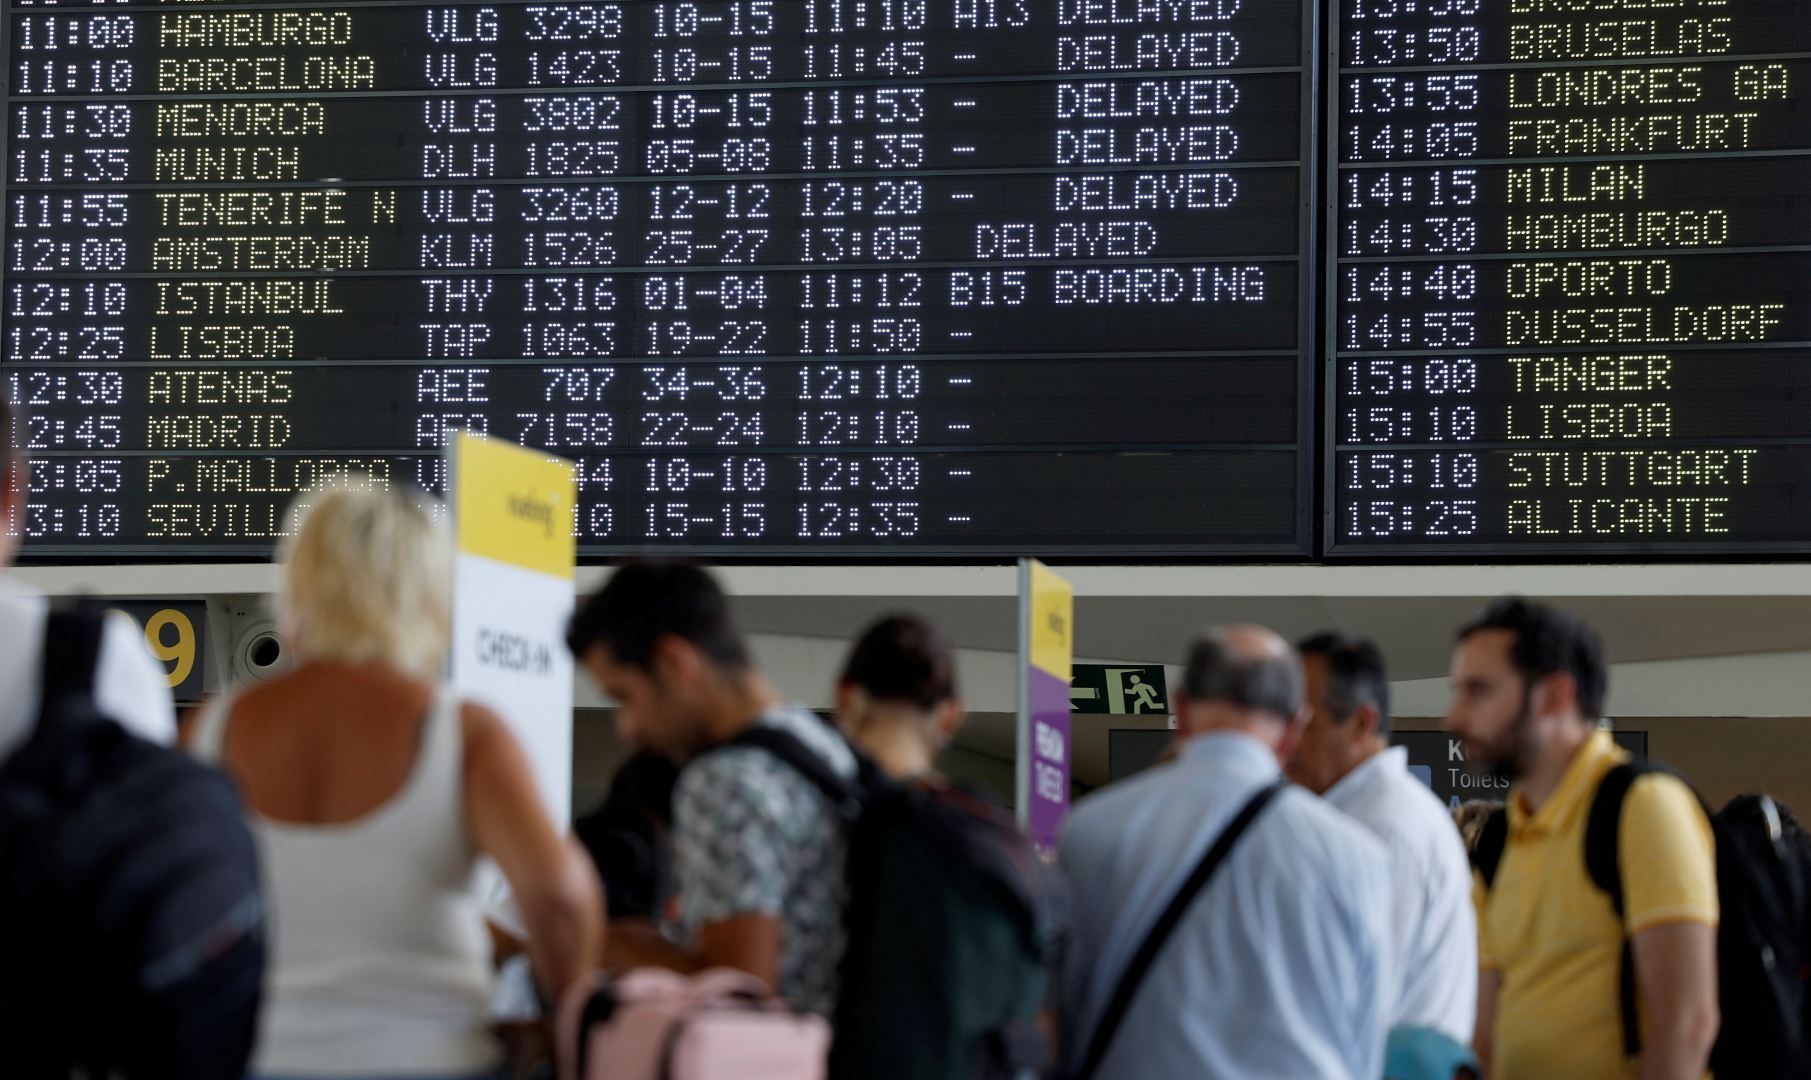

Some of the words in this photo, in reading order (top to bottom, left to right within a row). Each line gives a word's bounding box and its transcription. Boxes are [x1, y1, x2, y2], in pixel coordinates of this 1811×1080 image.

[21, 16, 133, 49] 11:00
[161, 12, 351, 47] HAMBURGO
[428, 9, 497, 42] VLG
[526, 6, 621, 40] 3298
[655, 2, 772, 37] 10-15
[806, 0, 925, 32] 11:10
[1351, 27, 1479, 65] 13:50
[1511, 18, 1731, 59] BRUSELAS
[20, 60, 132, 93] 11:10
[160, 56, 374, 91] BARCELONA
[426, 53, 496, 86] VLG
[529, 51, 620, 84] 1423
[654, 47, 771, 81] 10-15
[805, 42, 924, 77] 11:45
[1059, 32, 1239, 70] DELAYED
[18, 105, 130, 138] 11:30
[158, 103, 323, 136] MENORCA
[425, 100, 495, 132] VLG
[524, 97, 620, 130] 3802
[653, 93, 770, 128] 10-15
[804, 89, 924, 124] 11:53
[1058, 80, 1238, 118] DELAYED
[1349, 75, 1478, 113] 13:55
[1510, 67, 1702, 108] LONDRES
[1734, 64, 1787, 100] GA
[16, 149, 129, 181] 11:35
[156, 147, 298, 180] MUNICH
[424, 144, 494, 177] DLH
[527, 142, 618, 175] 1825
[647, 138, 769, 173] 05-08
[803, 134, 923, 169] 11:35
[1057, 126, 1237, 163] DELAYED
[1349, 122, 1477, 159] 14:05
[1509, 113, 1758, 155] FRANKFURT
[15, 194, 128, 227] 11:55
[156, 192, 346, 225] TENERIFE
[374, 192, 395, 223] N
[423, 190, 493, 222] VLG
[522, 187, 618, 221] 3260
[651, 185, 769, 219] 12-12
[802, 181, 921, 216] 12:20
[1056, 174, 1237, 210] DELAYED
[1348, 170, 1476, 207] 14:15
[1508, 165, 1643, 202] MILAN
[13, 239, 126, 270] 12:00
[153, 236, 368, 270] AMSTERDAM
[422, 234, 492, 267] KLM
[525, 233, 615, 265] 1526
[646, 230, 768, 263] 25-27
[801, 227, 921, 261] 13:05
[977, 222, 1156, 258] DELAYED
[1348, 217, 1475, 254] 14:30
[1507, 210, 1727, 249] HAMBURGO
[12, 283, 125, 315] 12:10
[157, 281, 343, 314] ISTANBUL
[422, 280, 492, 312] THY
[524, 278, 615, 311] 1316
[645, 276, 767, 309] 01-04
[801, 273, 921, 307] 11:12
[951, 271, 1025, 305] B15
[1056, 267, 1263, 303] BOARDING
[1347, 265, 1475, 301] 14:40
[1507, 260, 1671, 298] OPORTO
[11, 327, 124, 359] 12:25
[151, 326, 293, 358] LISBOA
[420, 324, 490, 356] TAP
[523, 323, 615, 355] 1063
[647, 320, 766, 354] 19-22
[800, 319, 920, 353] 11:50
[1347, 312, 1475, 348] 14:55
[1506, 305, 1784, 345] DUSSELDORF
[10, 372, 122, 404] 12:30
[150, 371, 292, 403] ATENAS
[418, 369, 489, 401] AEE
[544, 368, 614, 401] 707
[643, 367, 765, 400] 34-36
[799, 365, 919, 399] 12:10
[1347, 359, 1476, 395] 15:00
[1508, 355, 1672, 391] TANGER
[148, 416, 290, 447] MADRID
[517, 413, 612, 446] 7158
[642, 412, 765, 445] 22-24
[798, 411, 918, 444] 12:10
[1347, 407, 1475, 442] 15:10
[1507, 403, 1671, 439] LISBOA
[417, 459, 450, 491] VL
[646, 458, 765, 491] 10-10
[799, 457, 919, 490] 12:30
[1347, 454, 1476, 489] 15:10
[1509, 449, 1757, 487] STUTTGART
[646, 504, 764, 536] 15-15
[799, 503, 918, 536] 12:35
[1348, 501, 1476, 536] 15:25
[1508, 497, 1729, 534] ALICANTE
